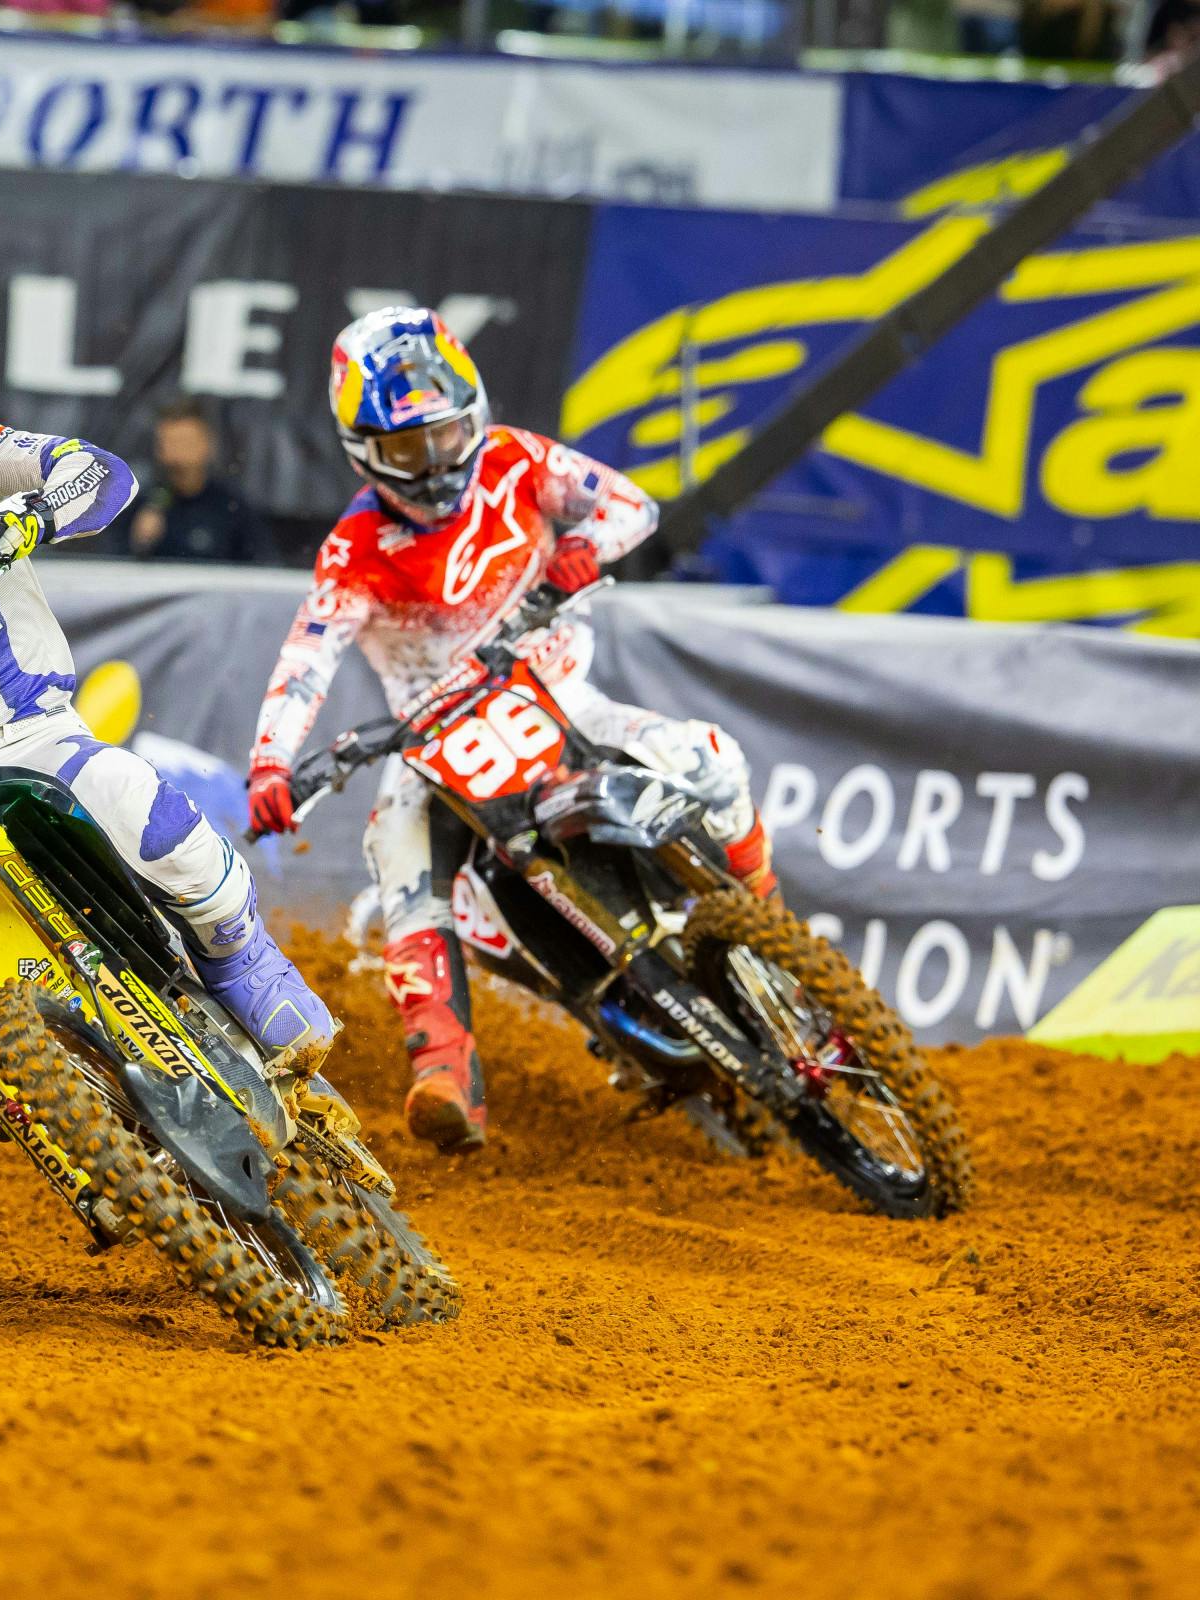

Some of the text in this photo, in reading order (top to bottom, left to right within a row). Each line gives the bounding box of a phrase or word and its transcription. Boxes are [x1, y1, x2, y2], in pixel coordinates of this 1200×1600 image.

[441, 684, 561, 798] 96
[763, 763, 1090, 881] PORTS
[98, 983, 192, 1079] DUNLOP
[652, 988, 744, 1072] DUNLOP
